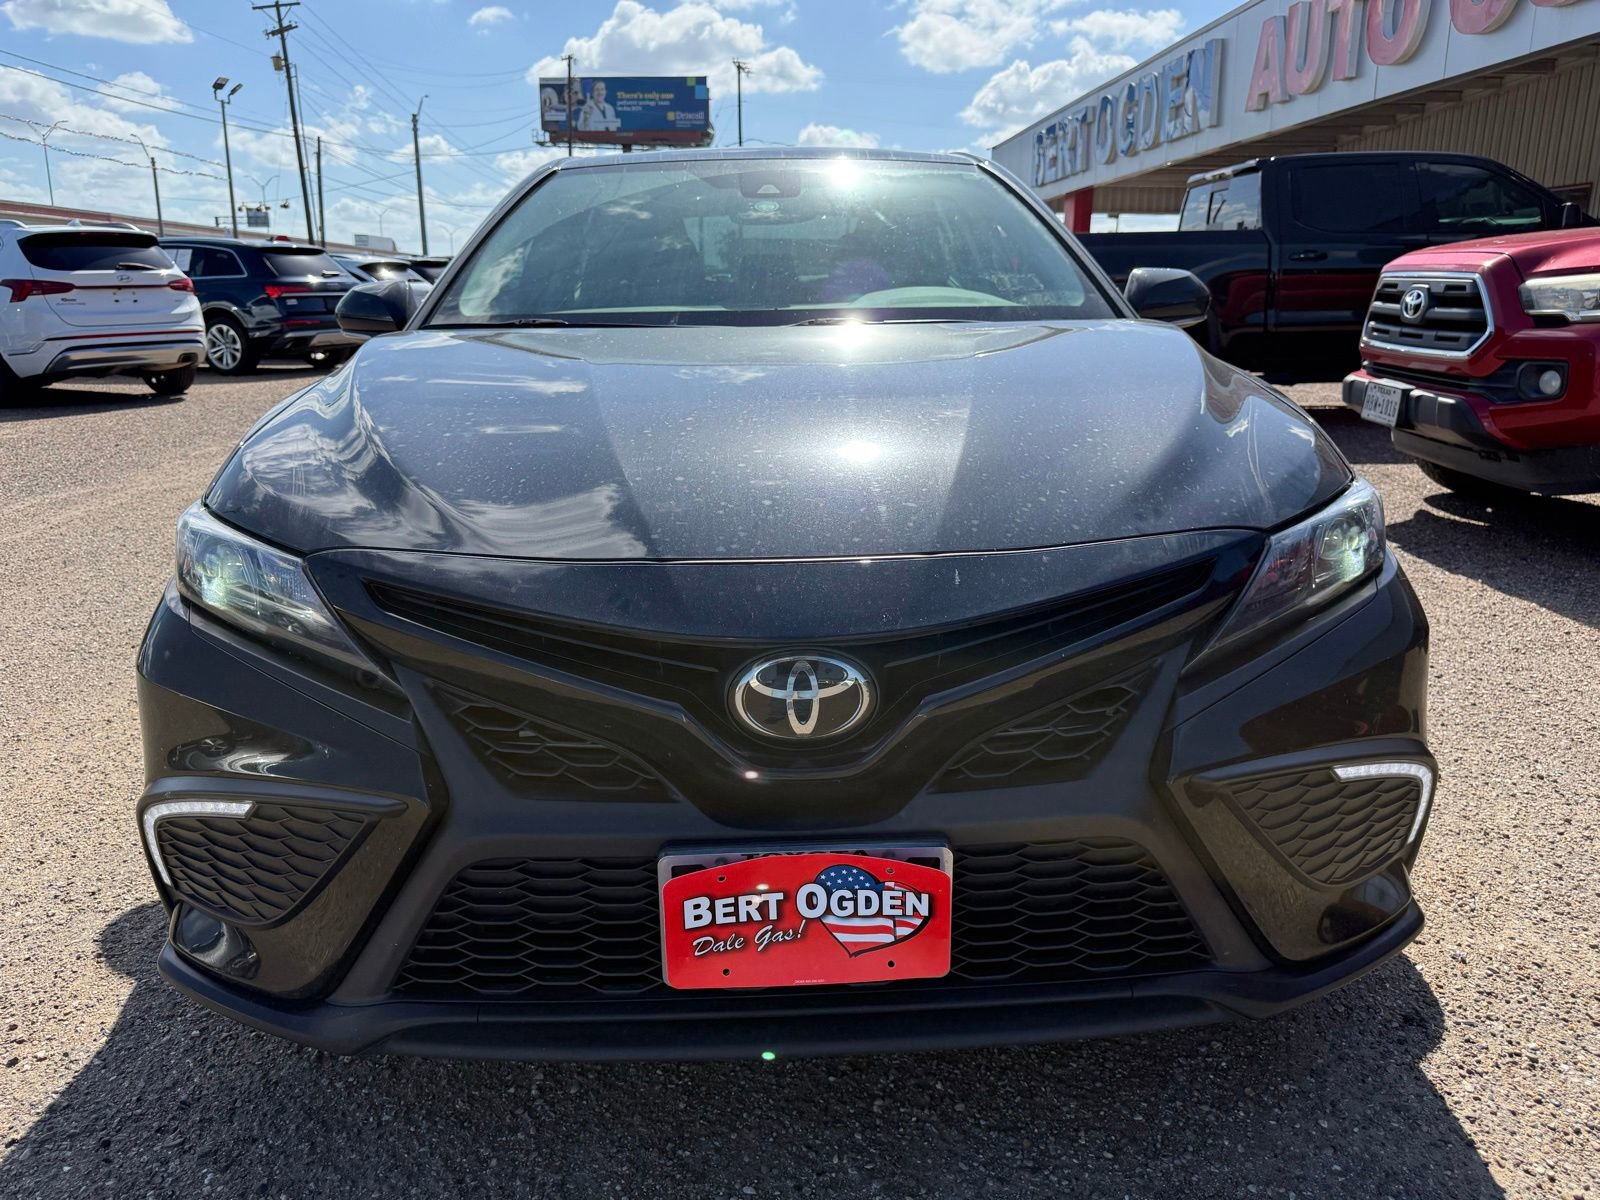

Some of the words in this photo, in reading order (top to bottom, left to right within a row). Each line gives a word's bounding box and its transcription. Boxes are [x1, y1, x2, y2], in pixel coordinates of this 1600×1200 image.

[1033, 105, 1096, 188] BERT
[1096, 38, 1224, 165] OGDEN
[1245, 0, 1432, 112] AUTO
[683, 892, 784, 930] BERT
[796, 883, 929, 919] OGDEN
[692, 933, 745, 956] Dale
[754, 919, 806, 952] Gas!
